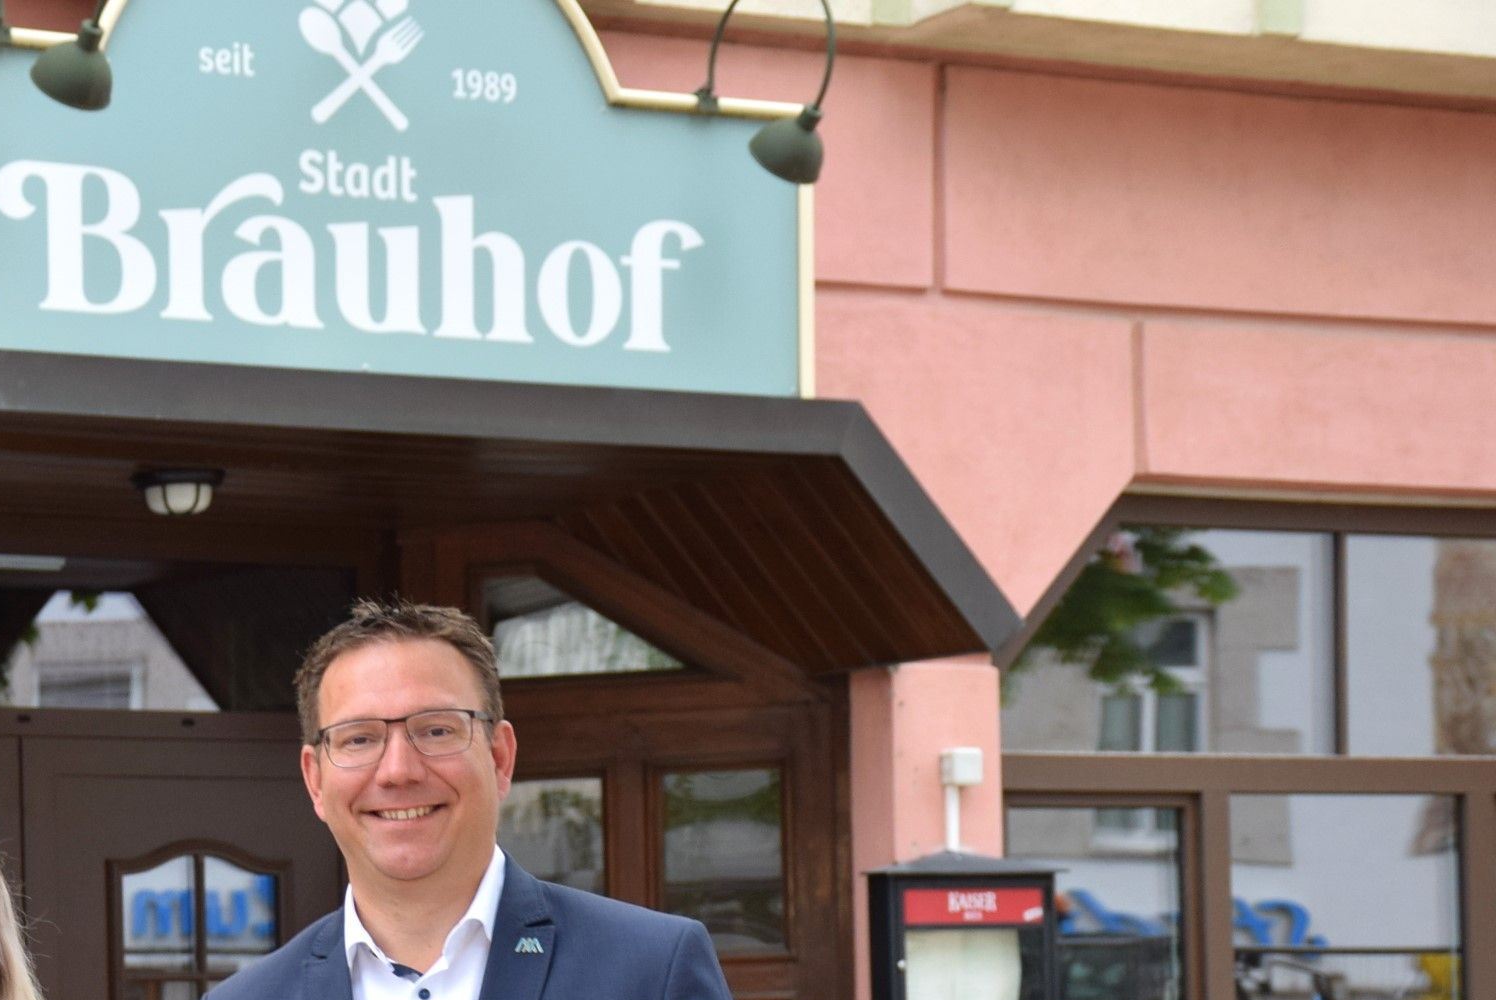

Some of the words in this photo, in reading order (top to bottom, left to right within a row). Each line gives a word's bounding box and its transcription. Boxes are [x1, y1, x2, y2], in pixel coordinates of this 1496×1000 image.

[198, 41, 256, 78] seit
[450, 67, 518, 104] 1989
[298, 148, 419, 203] Stadt
